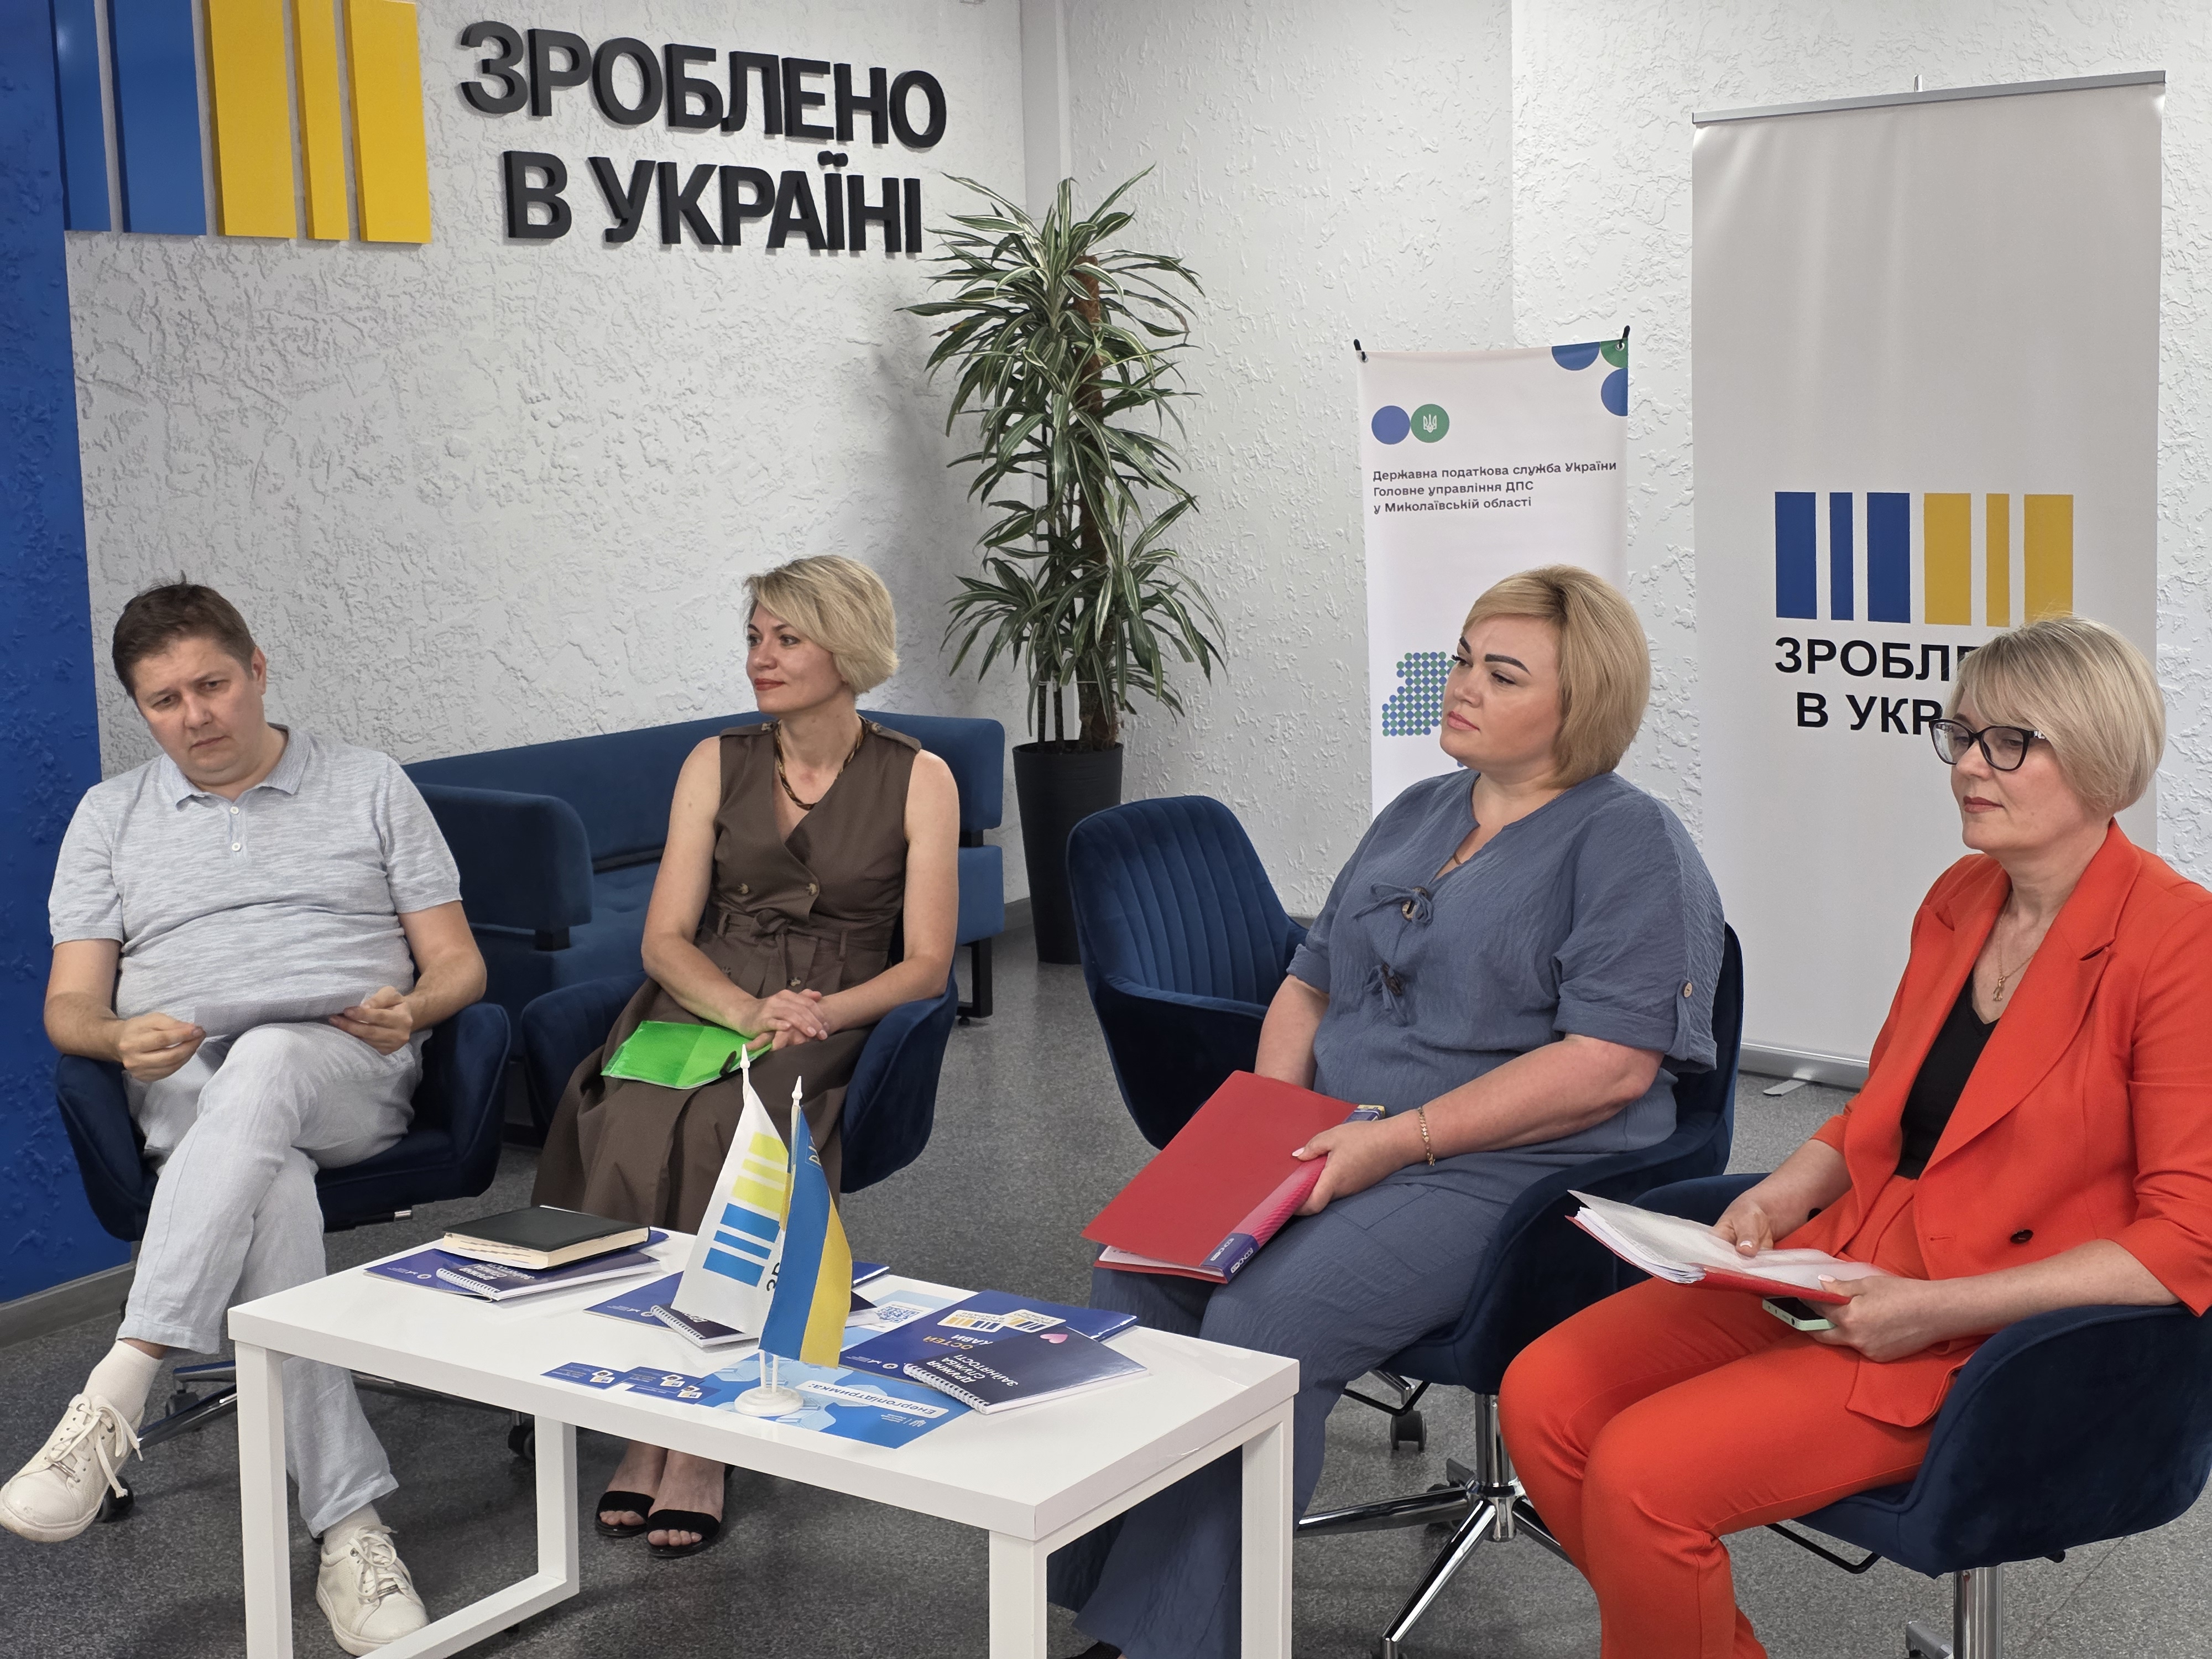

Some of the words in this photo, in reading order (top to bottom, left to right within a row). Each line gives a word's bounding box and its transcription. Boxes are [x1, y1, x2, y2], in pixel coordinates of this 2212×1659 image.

[460, 20, 947, 149] ЗРОБЛЕНО
[503, 150, 572, 239] В
[587, 150, 923, 254] УКРАЇНІ
[1373, 470, 1437, 481] Державна
[1442, 467, 1508, 478] податкова
[1514, 463, 1561, 476] служба
[1566, 461, 1616, 473] України
[1374, 488, 1424, 496] Головне
[1429, 484, 1501, 496] управління
[1506, 481, 1533, 492] ДПС
[1374, 505, 1380, 514] у
[1385, 499, 1479, 512] Миколаївській
[1484, 497, 1531, 508] області
[1775, 637, 1981, 681] ЗРОБЛ
[1797, 692, 1828, 728] В
[926, 1360, 977, 1383] ДРУЖНЯ
[941, 1357, 985, 1379] СЛУЖБА
[953, 1354, 1019, 1386] ЗАЙНЯТОСТІ
